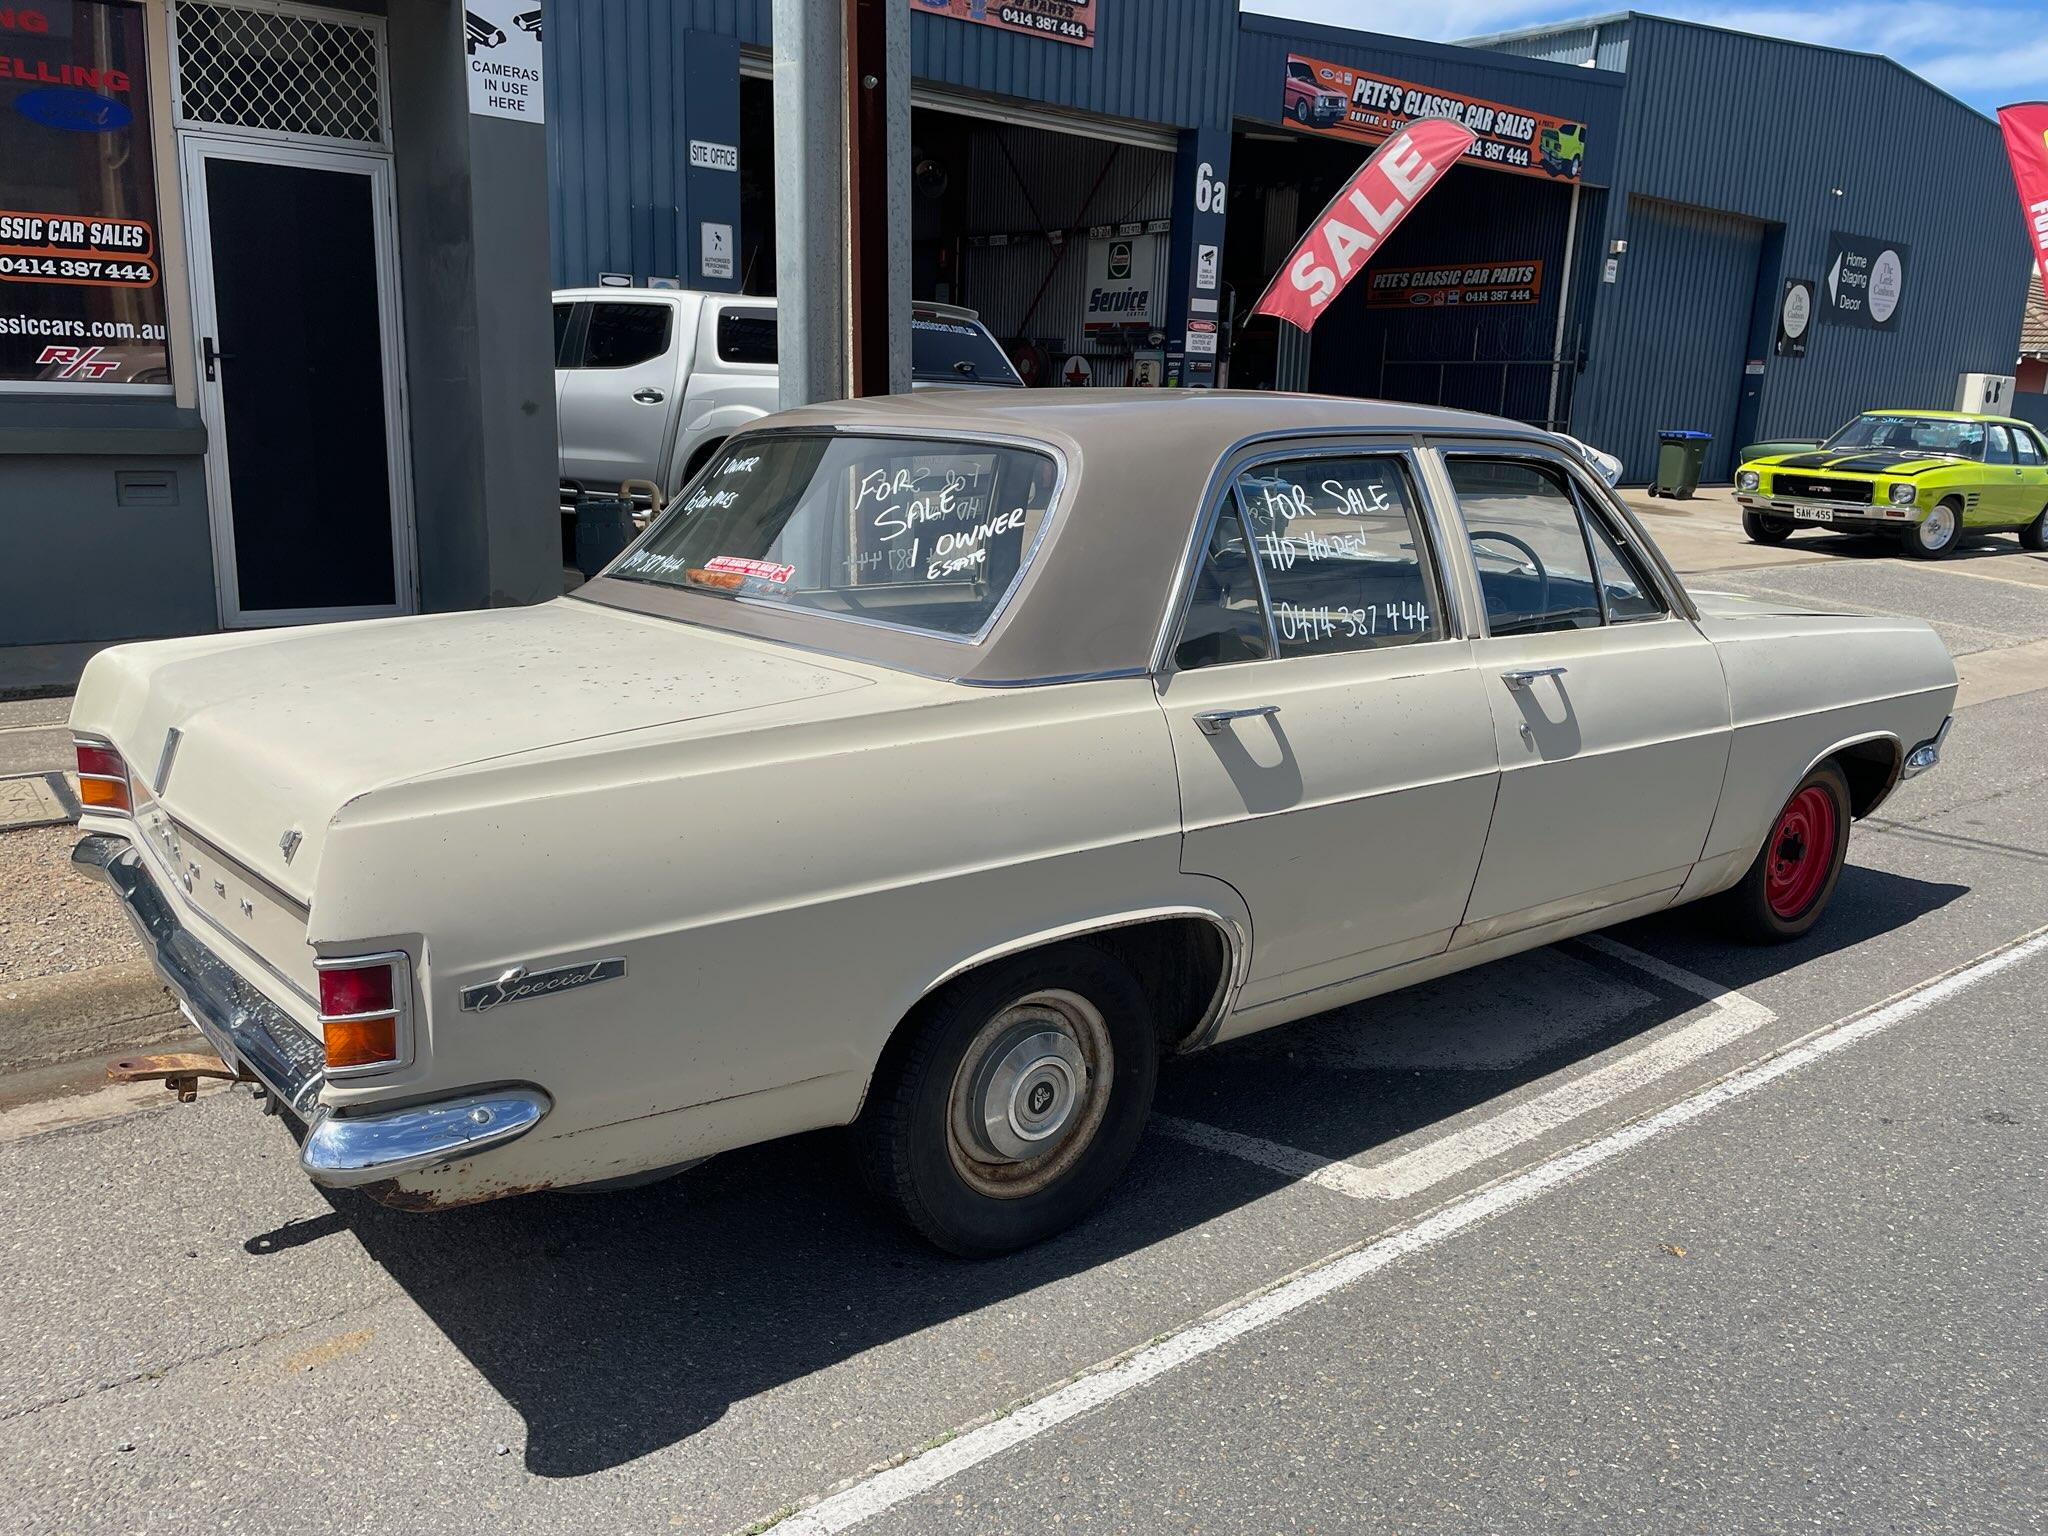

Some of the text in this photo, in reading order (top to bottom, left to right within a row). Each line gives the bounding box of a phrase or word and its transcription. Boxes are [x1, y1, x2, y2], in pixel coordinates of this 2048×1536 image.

[1002, 8, 1084, 38] 0414 387 444
[472, 60, 539, 82] CAMERAS
[484, 78, 528, 96] IN USE
[489, 95, 526, 112] HERE
[1352, 77, 1536, 141] PETE'S CLASSIC CAR SALES
[1350, 110, 1379, 126] BUYING
[1382, 119, 1388, 127] &
[692, 144, 735, 167] SITE OFFICE
[1484, 141, 1505, 161] 387
[1506, 144, 1529, 166] 444
[1196, 162, 1226, 214] 6a
[0, 217, 143, 247] SSIC CAR SALES
[1289, 132, 1437, 308] SALE
[0, 257, 151, 281] 0414 387 444
[1846, 252, 1867, 269] Home
[1373, 266, 1534, 289] PETE'S CLASSIC CAR PARTS
[1841, 268, 1868, 288] Staging
[1088, 286, 1149, 313] Service
[1466, 292, 1489, 302] 0414
[1491, 291, 1508, 301] 387
[1510, 290, 1530, 300] 444
[1840, 294, 1861, 311] Decor
[0, 314, 166, 340] ssiccars.com.au
[35, 345, 121, 379] R/T
[854, 468, 914, 510] FOR
[1263, 484, 1317, 519] FOR
[1321, 479, 1389, 515] SALE
[874, 483, 960, 541] SALE
[935, 508, 1026, 556] OWNER
[1265, 525, 1367, 571] HD HOLDEN
[926, 549, 986, 580] ESTATE
[1281, 601, 1429, 642] 0414 387 444
[476, 962, 606, 1013] Special
